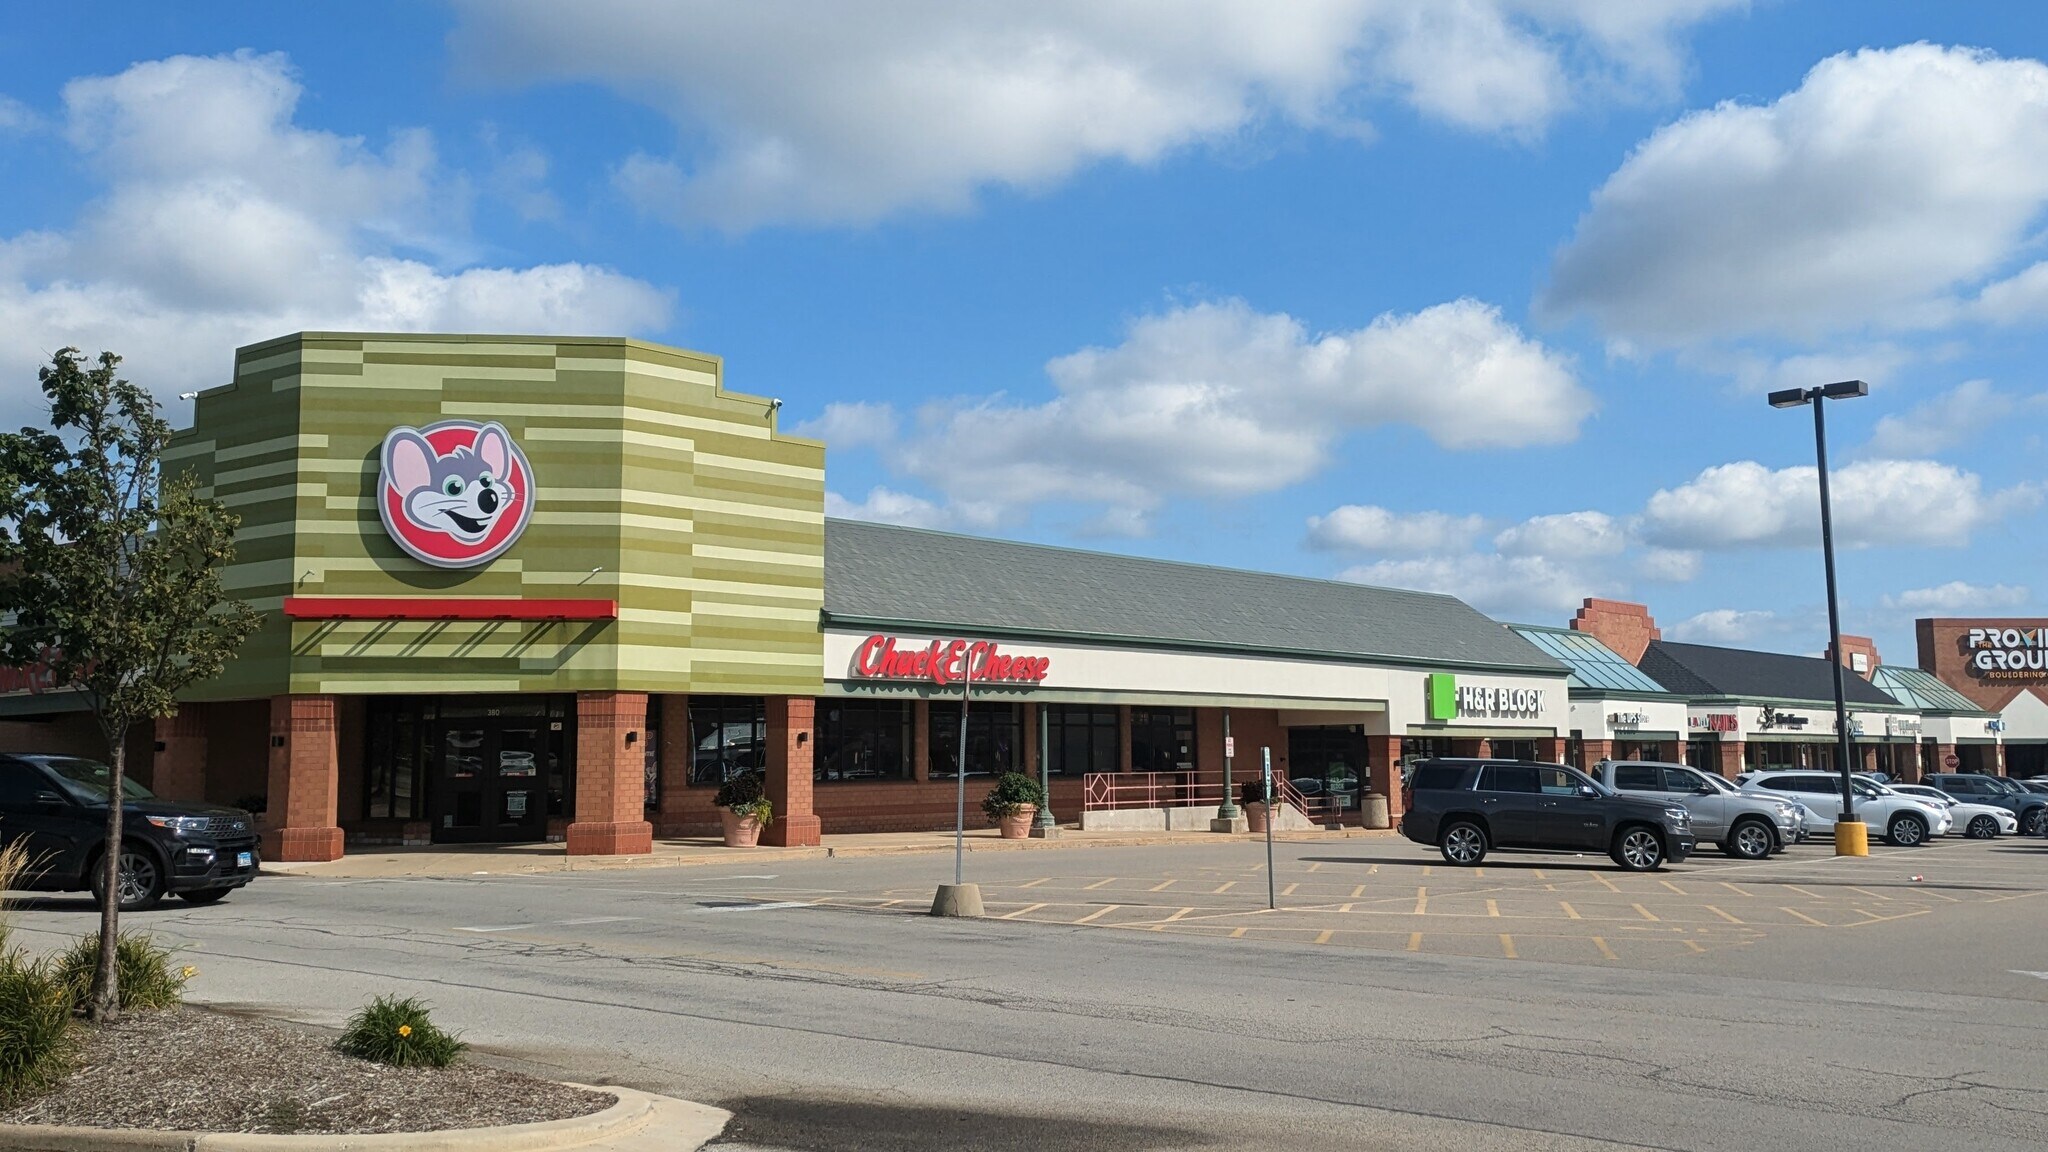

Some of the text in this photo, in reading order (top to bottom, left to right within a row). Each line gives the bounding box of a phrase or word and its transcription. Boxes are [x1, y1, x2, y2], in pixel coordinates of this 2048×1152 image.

[860, 634, 947, 684] Chuck
[969, 640, 1050, 681] Cheese
[1976, 650, 2048, 669] GROU
[1463, 686, 1546, 712] H&R BLOCK
[1708, 714, 1739, 731] NAILS
